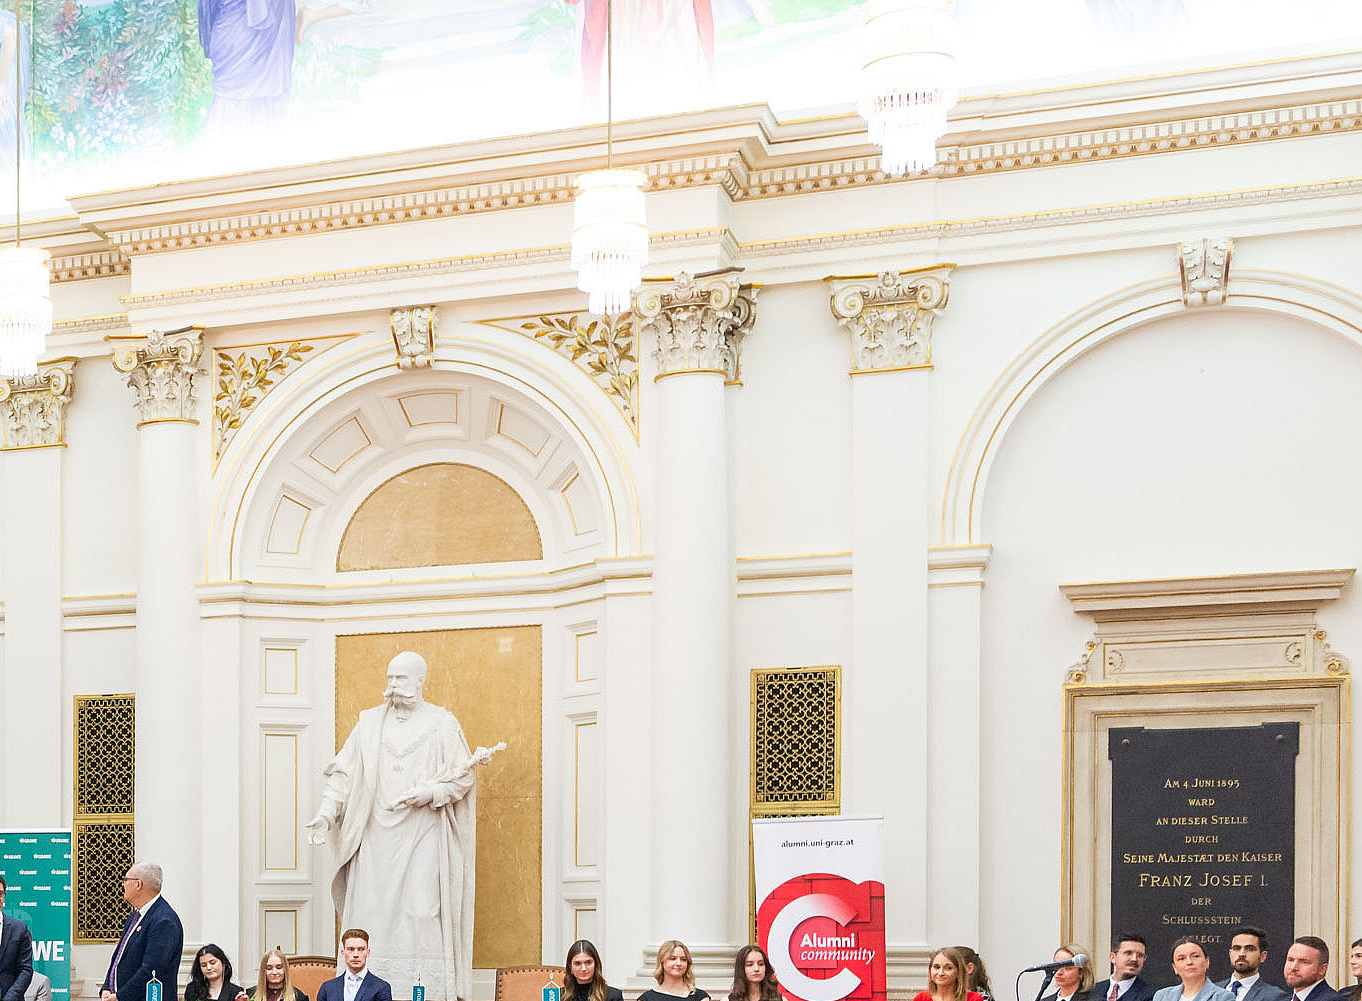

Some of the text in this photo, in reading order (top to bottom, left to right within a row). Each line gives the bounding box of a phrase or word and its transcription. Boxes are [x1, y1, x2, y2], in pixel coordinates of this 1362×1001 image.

[1183, 780, 1188, 790] 4
[1217, 779, 1240, 789] 1895
[1188, 798, 1215, 807] WARD
[1156, 817, 1169, 826] AN
[1171, 816, 1208, 825] DIESER
[781, 839, 854, 849] alumni.uni-graz.at
[1185, 835, 1219, 844] DURCH
[1217, 854, 1239, 863] DEN
[1191, 897, 1212, 906] DER
[800, 932, 855, 948] Alumni
[800, 947, 876, 965] community
